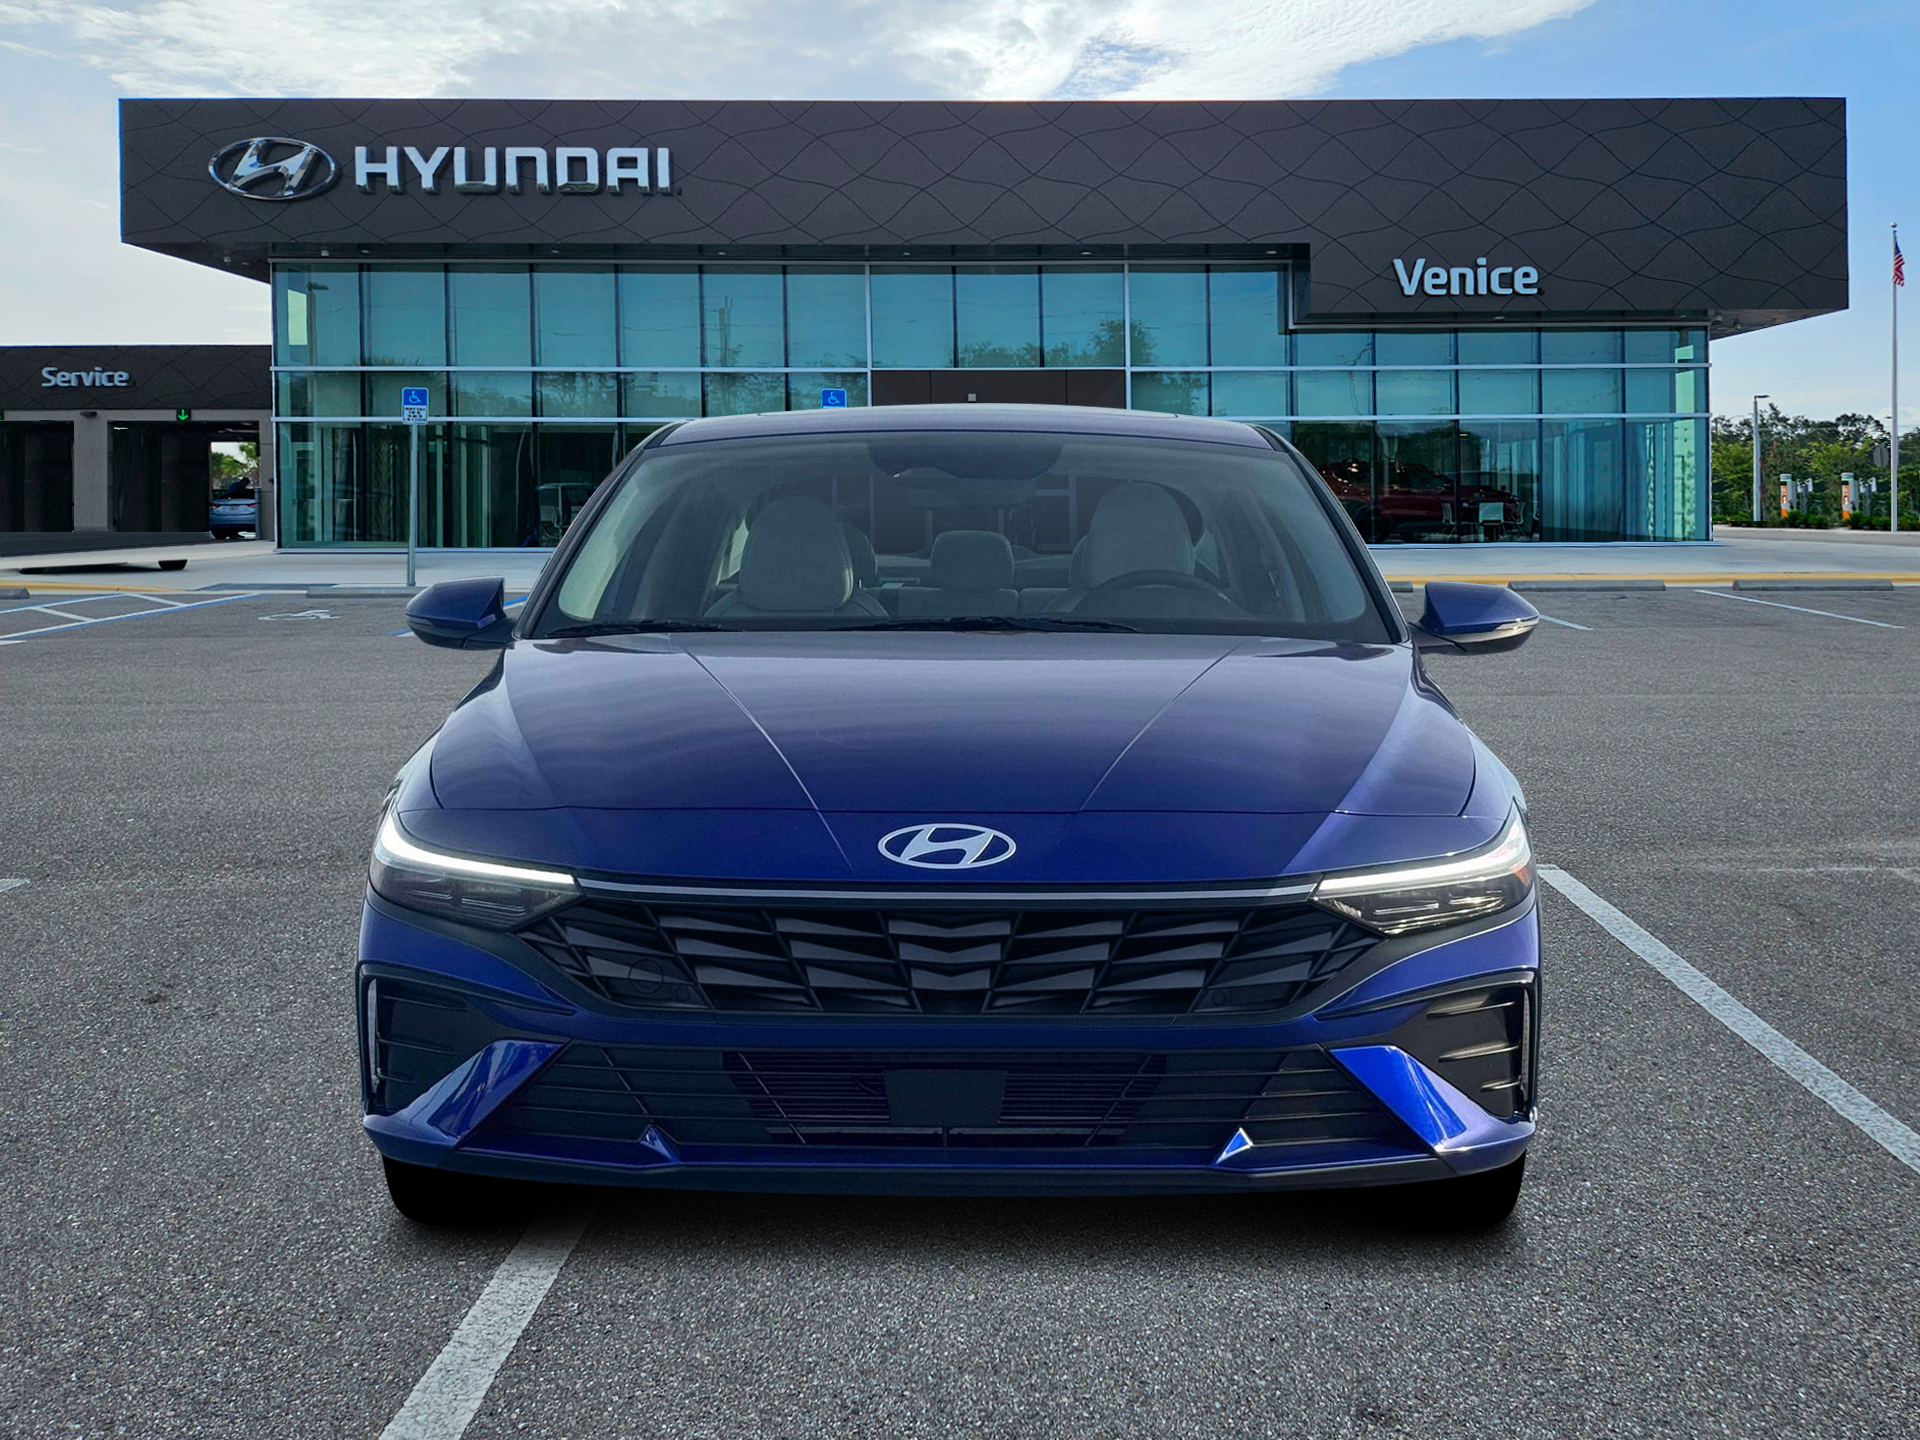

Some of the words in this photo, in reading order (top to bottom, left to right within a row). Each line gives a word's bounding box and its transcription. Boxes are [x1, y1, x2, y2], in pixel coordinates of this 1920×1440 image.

[354, 146, 672, 194] HYUNDAI
[1392, 257, 1539, 296] Venice
[41, 366, 130, 387] Service
